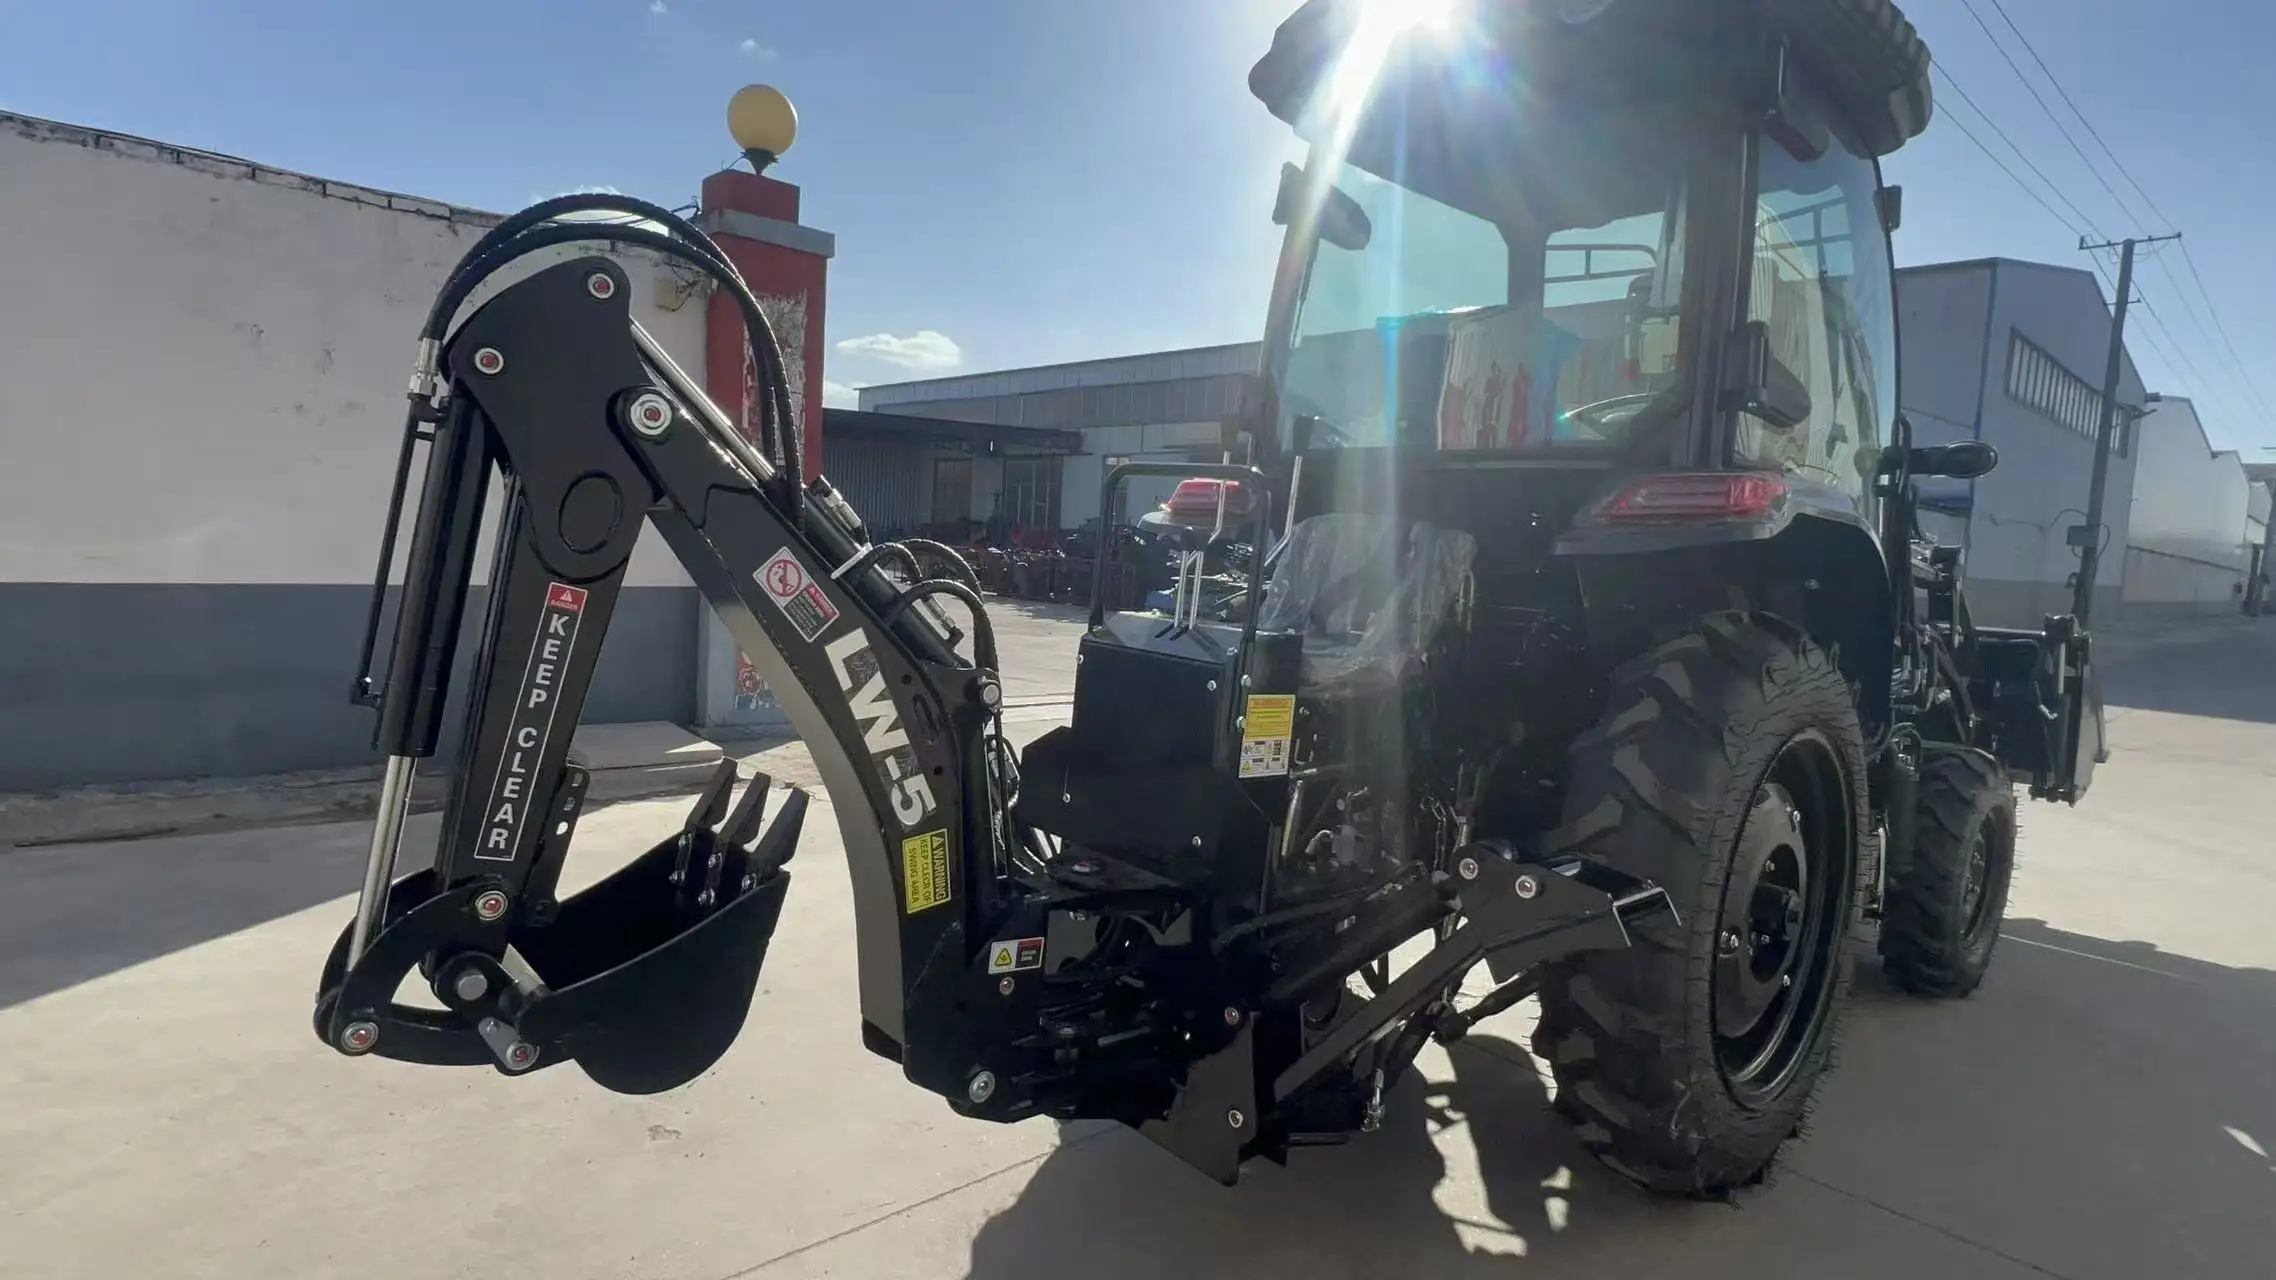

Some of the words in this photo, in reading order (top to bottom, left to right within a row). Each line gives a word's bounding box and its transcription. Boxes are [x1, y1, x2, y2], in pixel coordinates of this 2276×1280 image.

[528, 613, 570, 708] KEEP
[824, 627, 936, 825] LW-5
[488, 727, 538, 849] CLEAR
[908, 847, 919, 878] SWING
[920, 838, 929, 860] KEEP
[911, 881, 920, 904] AREA
[933, 847, 946, 900] WARNING
[923, 891, 932, 902] OF
